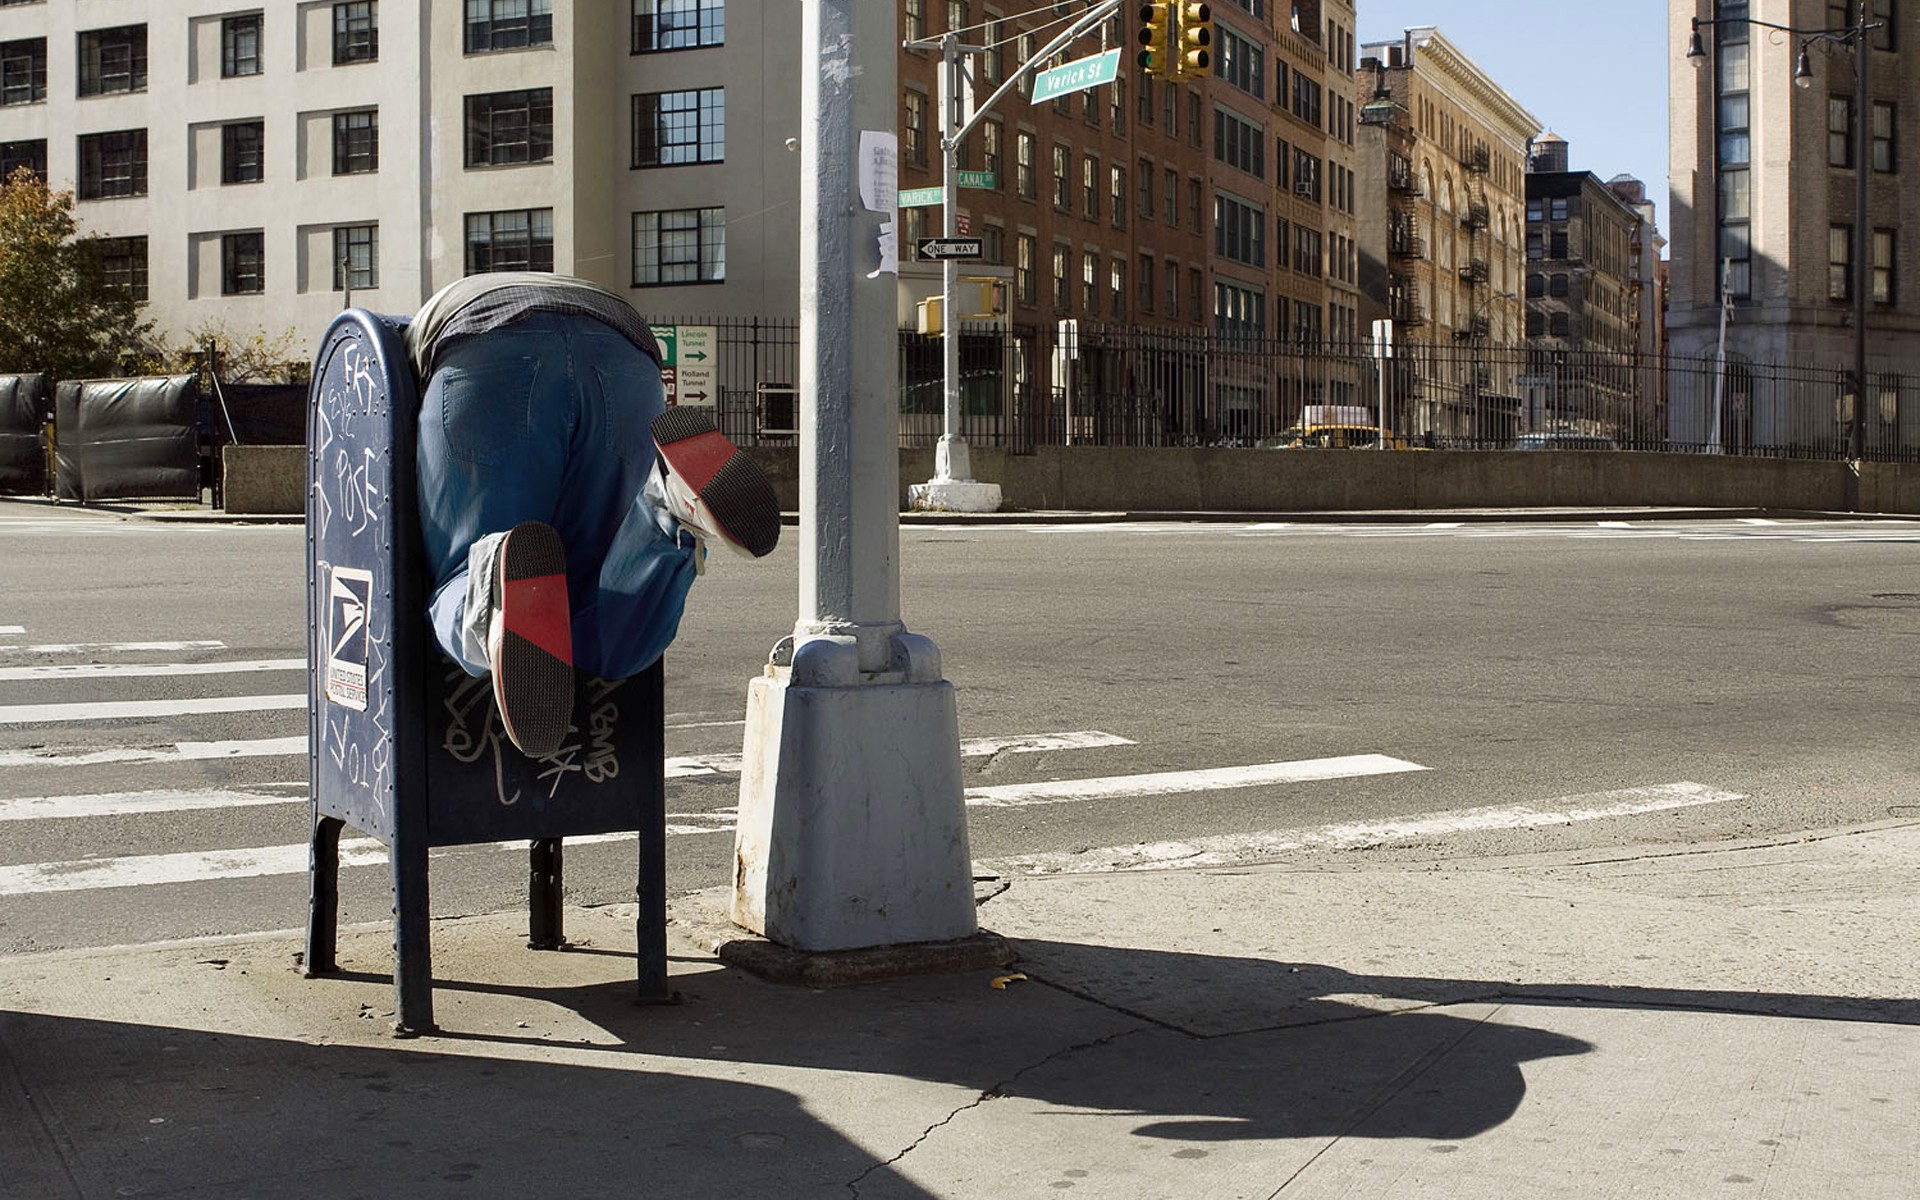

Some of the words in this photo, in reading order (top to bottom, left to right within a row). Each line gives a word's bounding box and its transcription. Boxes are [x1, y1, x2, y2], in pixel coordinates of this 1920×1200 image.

[1047, 66, 1085, 91] Varick
[1087, 62, 1103, 79] St
[958, 173, 985, 186] CANAL
[900, 190, 933, 206] VARICK
[927, 243, 946, 254] ONE
[954, 243, 974, 254] WAY
[681, 329, 708, 338] Lincoln
[682, 339, 706, 347] Tunnel
[681, 370, 710, 378] Holland
[330, 682, 346, 698] POSTAL
[346, 687, 366, 703] SERVICE
